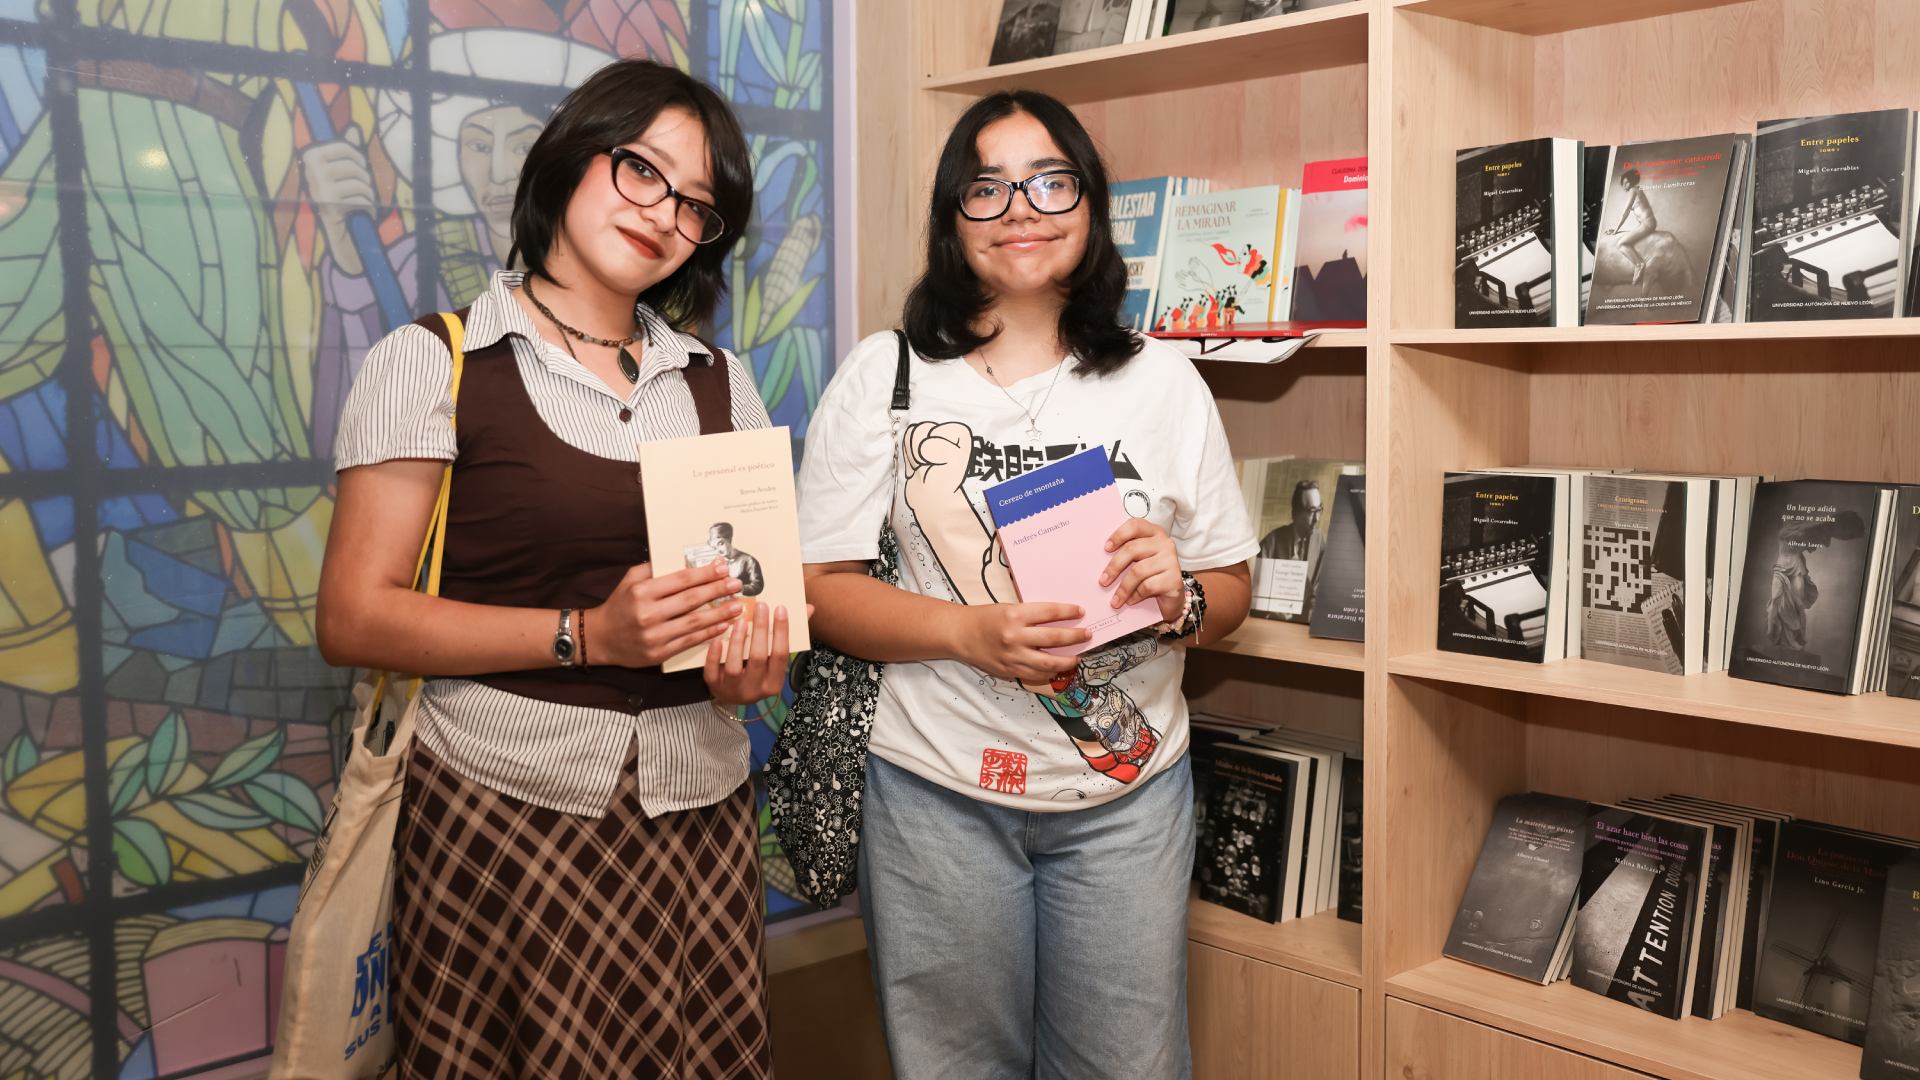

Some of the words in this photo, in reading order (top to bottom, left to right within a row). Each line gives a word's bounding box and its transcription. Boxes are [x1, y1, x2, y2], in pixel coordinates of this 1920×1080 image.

[1826, 136, 1859, 146] papeles
[1485, 164, 1501, 172] Entre
[1501, 161, 1522, 171] papeles
[1798, 167, 1819, 175] Miguel
[1821, 165, 1859, 173] Covarrubias
[1175, 201, 1236, 217] REIMAGINAR
[1177, 219, 1190, 231] LA
[1194, 216, 1231, 229] MIRADA
[692, 469, 703, 478] Lo
[704, 464, 736, 478] personal
[747, 462, 776, 473] poético
[998, 494, 1024, 507] Cerezo
[1024, 490, 1033, 498] de
[1033, 478, 1065, 494] montaña
[1475, 491, 1493, 499] Entre
[1494, 493, 1519, 501] papeles
[1798, 504, 1816, 513] largo
[1817, 505, 1836, 513] adiós
[1781, 514, 1795, 522] que
[1815, 515, 1836, 523] acaba
[1037, 520, 1070, 536] Camacho
[1596, 821, 1605, 830] El
[1605, 825, 1621, 834] azar
[1622, 827, 1640, 839] hace
[1640, 831, 1657, 843] bien
[1658, 836, 1668, 846] las
[1669, 841, 1689, 851] cosas
[1614, 857, 1635, 868] Melina
[1814, 876, 1830, 886] Lino
[1856, 886, 1865, 894] Jr.
[1627, 889, 1678, 1012] ATTENTION
